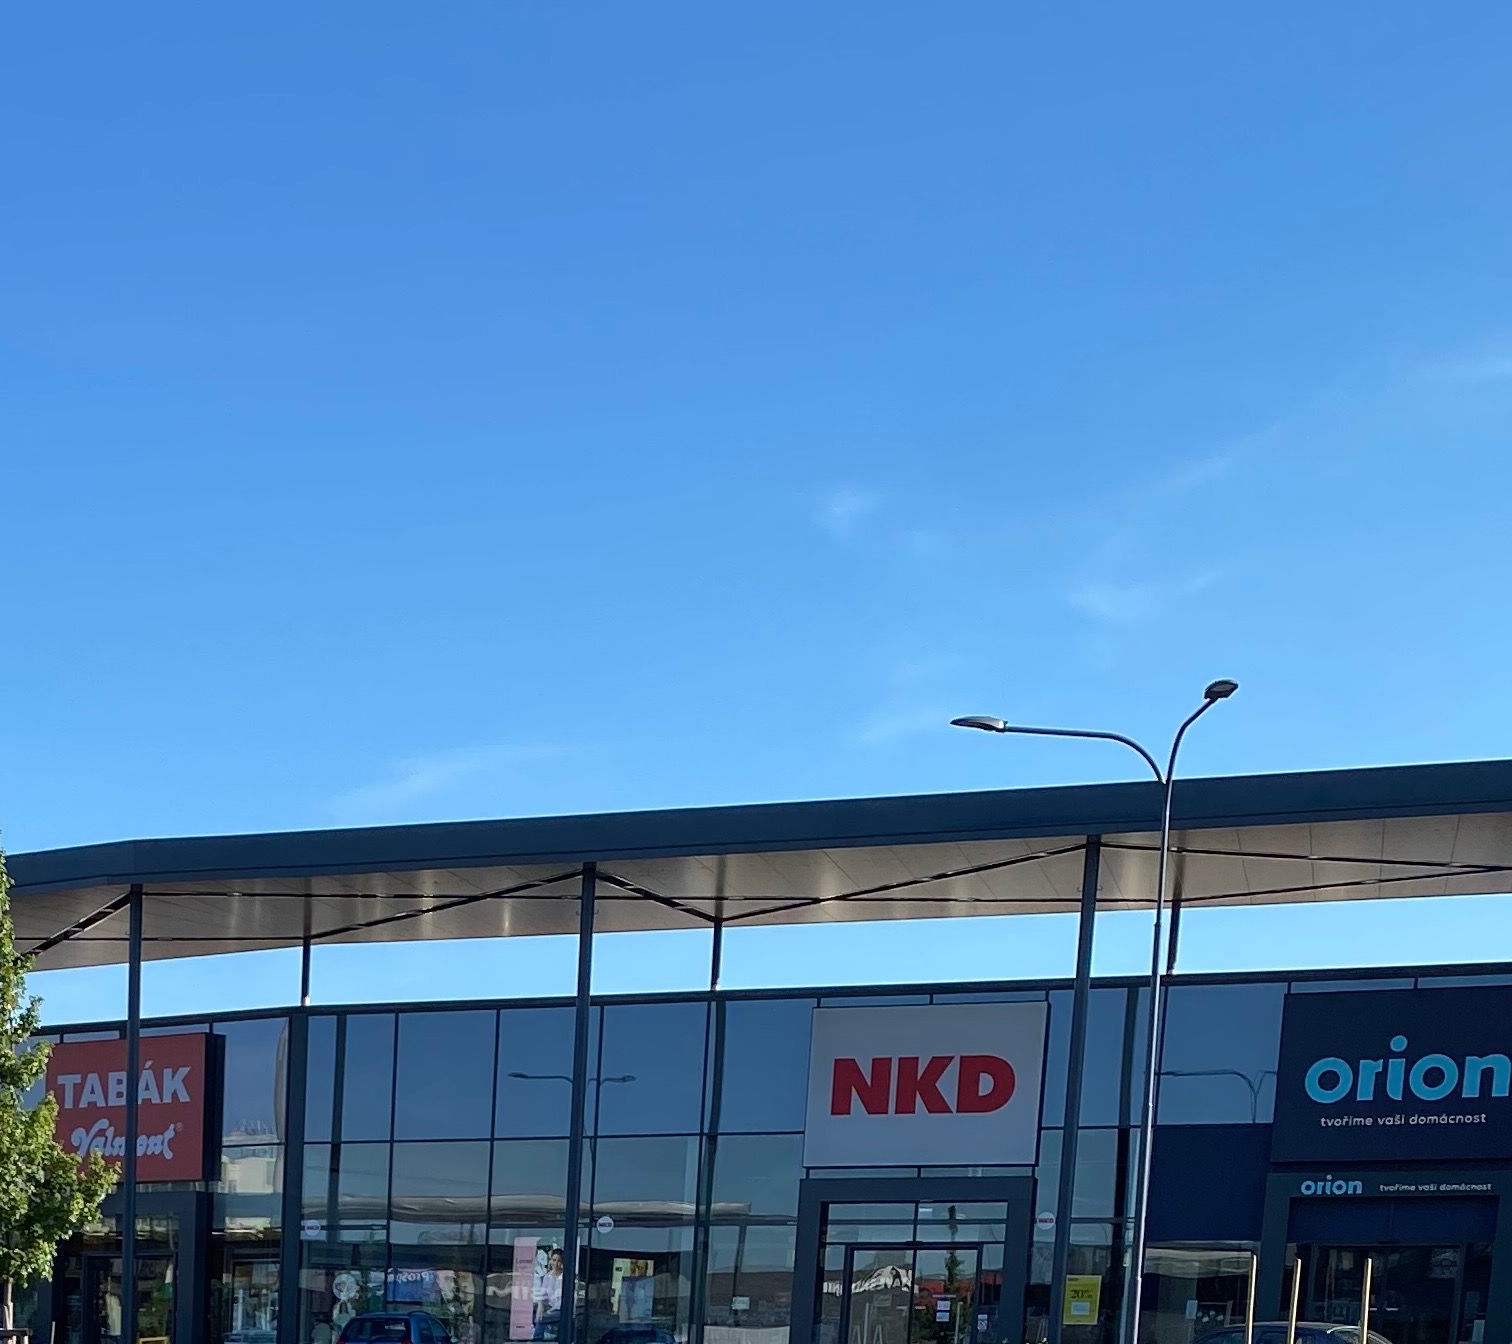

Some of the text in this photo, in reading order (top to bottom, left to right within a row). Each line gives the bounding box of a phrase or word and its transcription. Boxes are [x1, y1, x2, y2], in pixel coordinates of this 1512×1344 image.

[57, 1059, 192, 1109] TABÁK
[830, 1054, 1016, 1116] NKD
[1304, 1034, 1512, 1104] orion
[1377, 1113, 1405, 1126] vaši
[1408, 1113, 1487, 1126] domácnost
[1300, 1174, 1363, 1195] orion
